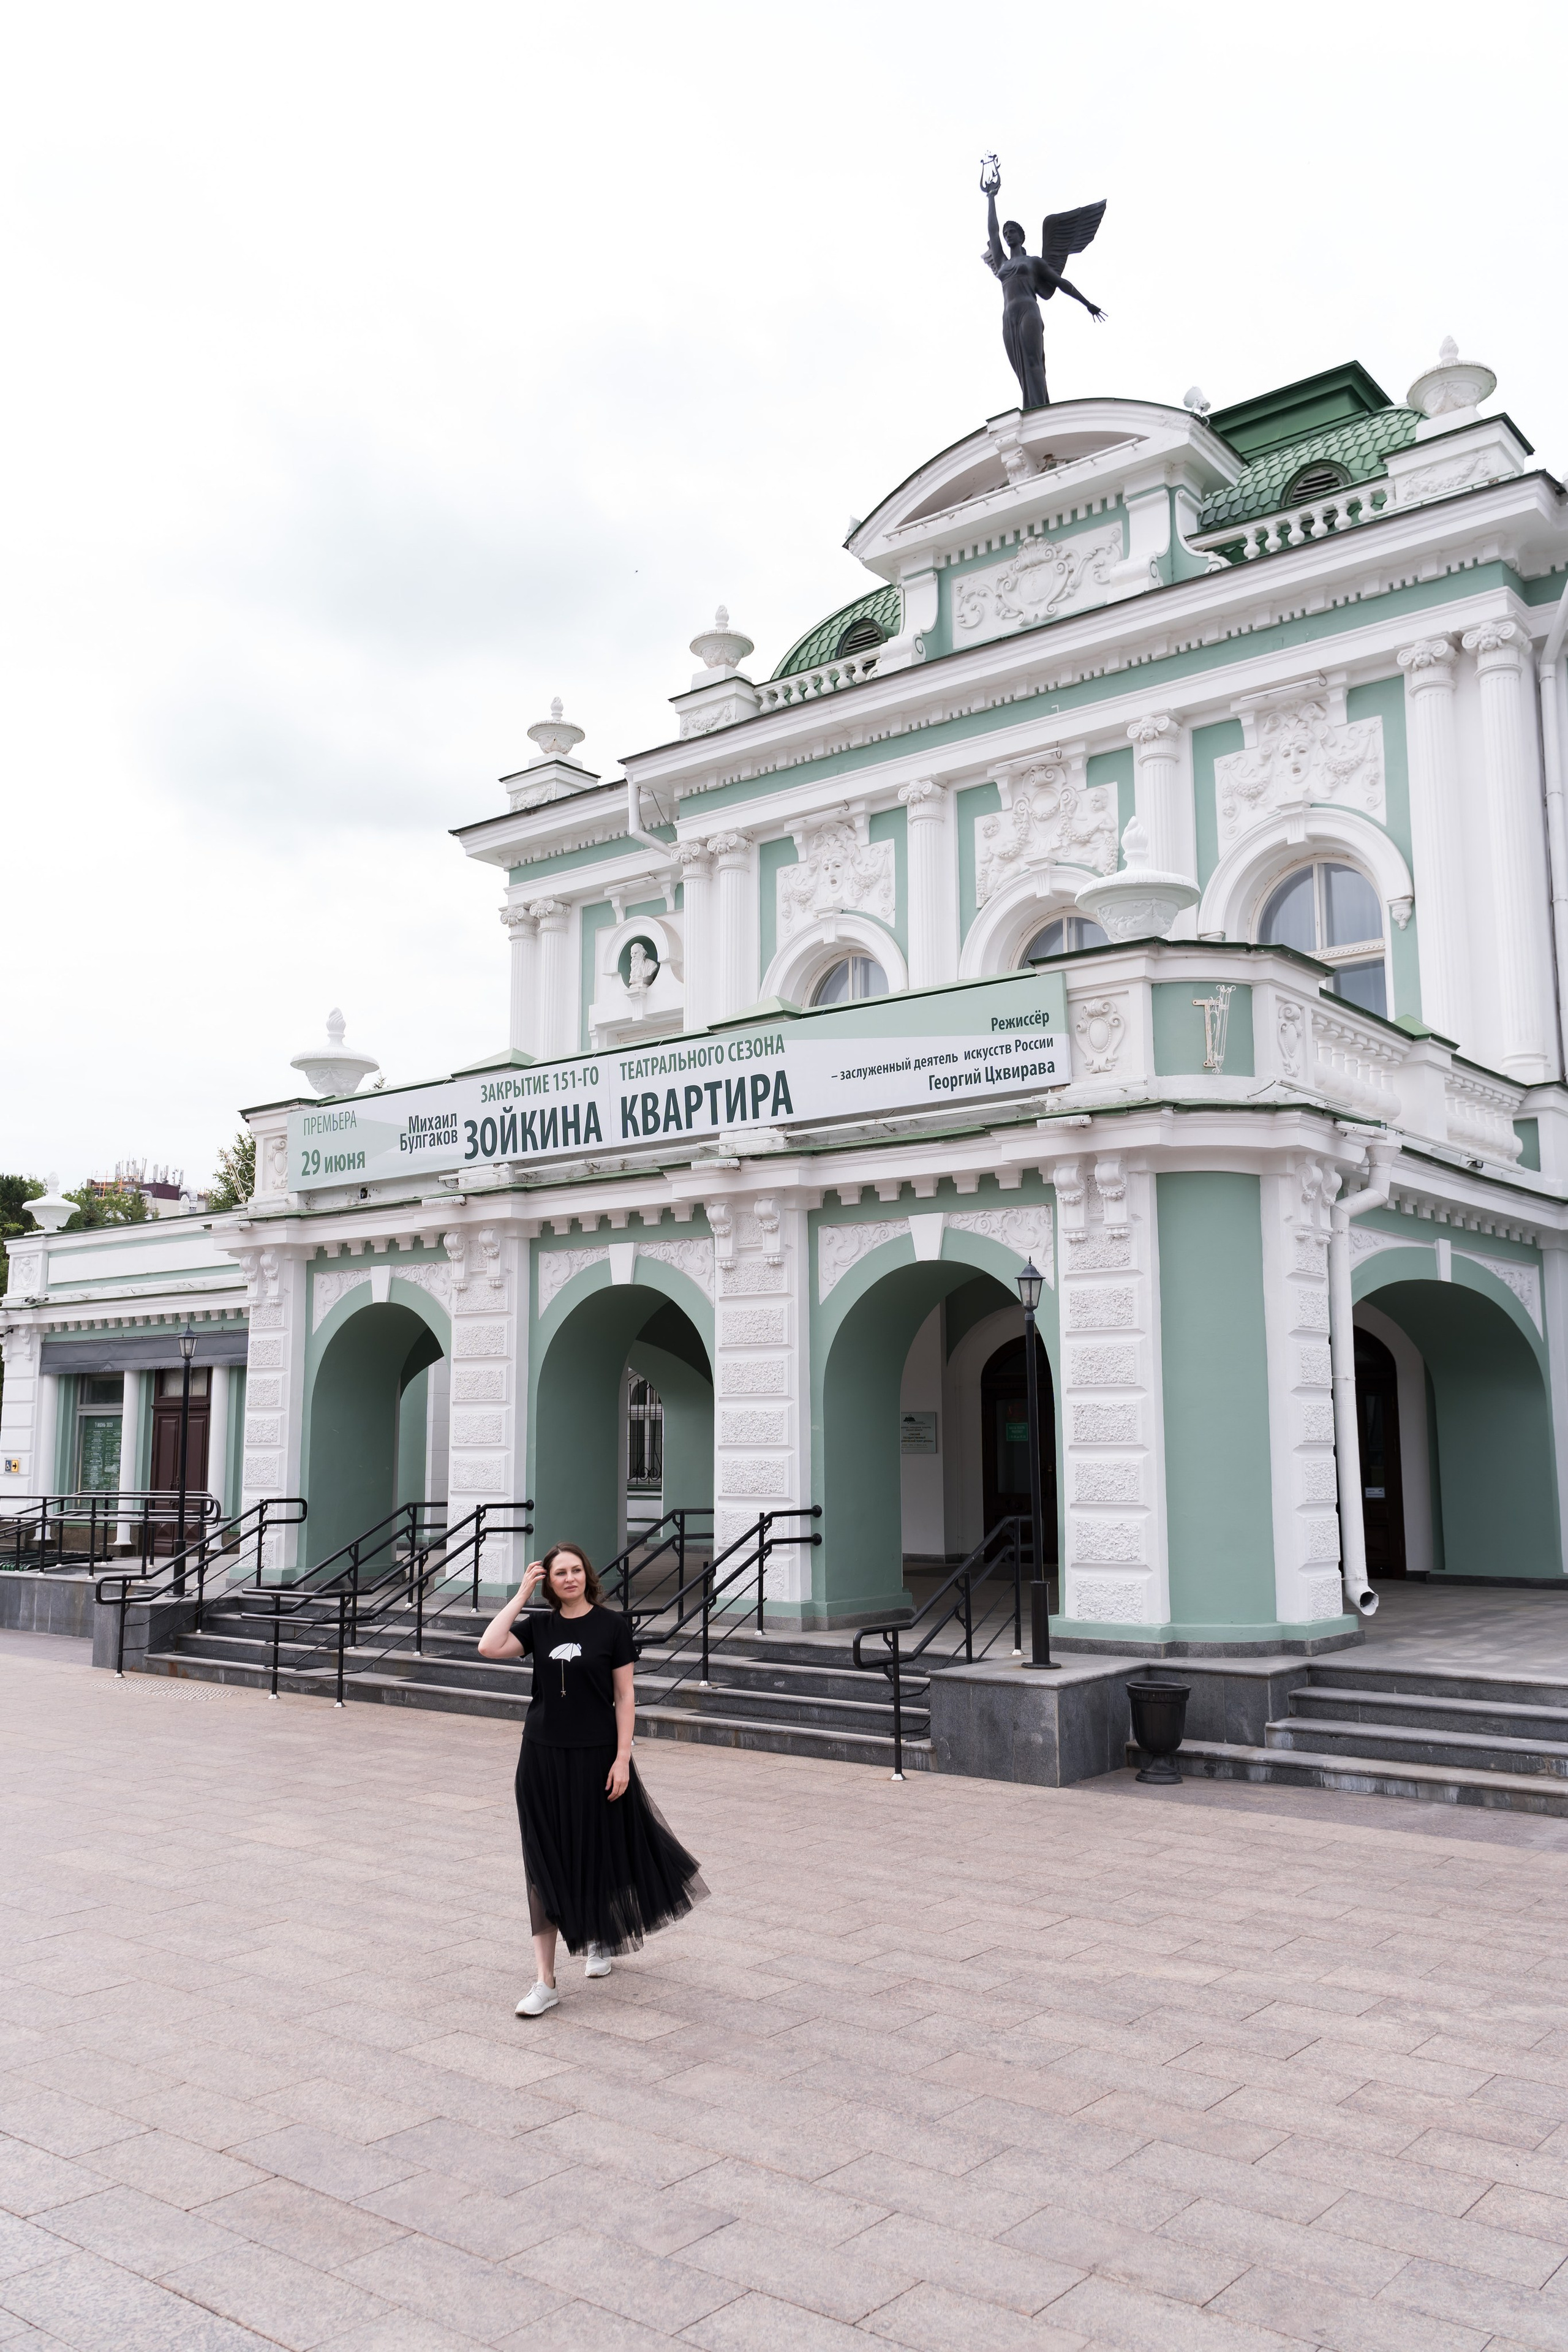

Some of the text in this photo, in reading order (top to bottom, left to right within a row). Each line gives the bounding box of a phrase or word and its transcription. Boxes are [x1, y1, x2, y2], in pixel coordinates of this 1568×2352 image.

[990, 1010, 1050, 1031] Режиссёр
[480, 1033, 785, 1103] ЗАКРЫТИЕ 151-ГО ТЕАТРАЛЬНОГО СЕЗОНА
[840, 1057, 911, 1080] заслуженный
[913, 1052, 959, 1071] деятель
[963, 1043, 1012, 1061] искусств
[1014, 1037, 1054, 1053] России
[928, 1060, 1055, 1091] Георгий Цхвирава
[303, 1110, 357, 1136] ПРЕМЬЕРА
[408, 1113, 458, 1134] Михаил
[464, 1069, 794, 1160] ЗОЙКИНА КВАРТИРА
[399, 1129, 458, 1154] Булгаков
[301, 1149, 366, 1176] 29 июня
